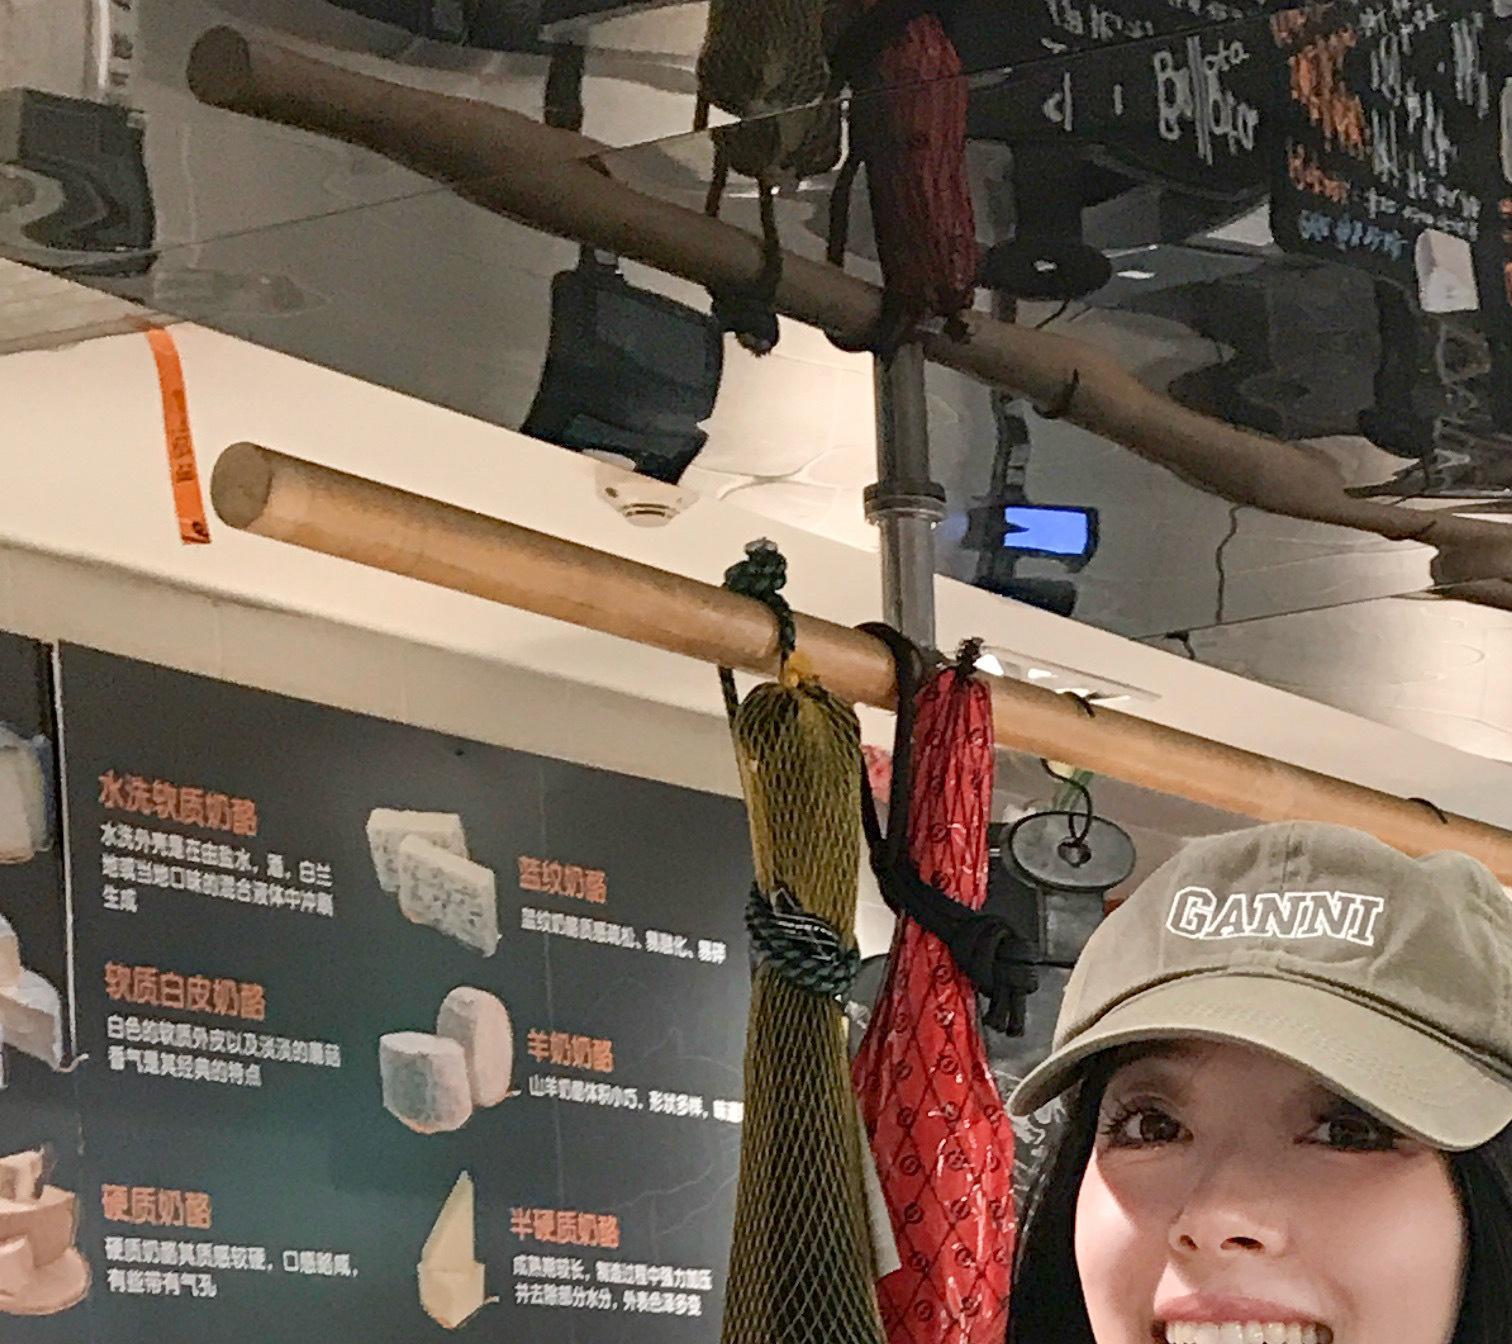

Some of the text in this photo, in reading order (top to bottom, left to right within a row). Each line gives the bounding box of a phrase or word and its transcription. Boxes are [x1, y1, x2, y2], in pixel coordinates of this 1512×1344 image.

[98, 768, 257, 836] 水洗软质奶酪
[518, 855, 608, 904] 蓝纹奶酪
[1165, 886, 1385, 946] GANNI
[104, 961, 266, 1021] 软质白皮奶酪
[527, 1028, 614, 1073] 羊奶奶酪
[101, 1184, 213, 1229] 硬质奶酪
[510, 1206, 621, 1249] 半硬质奶酪
